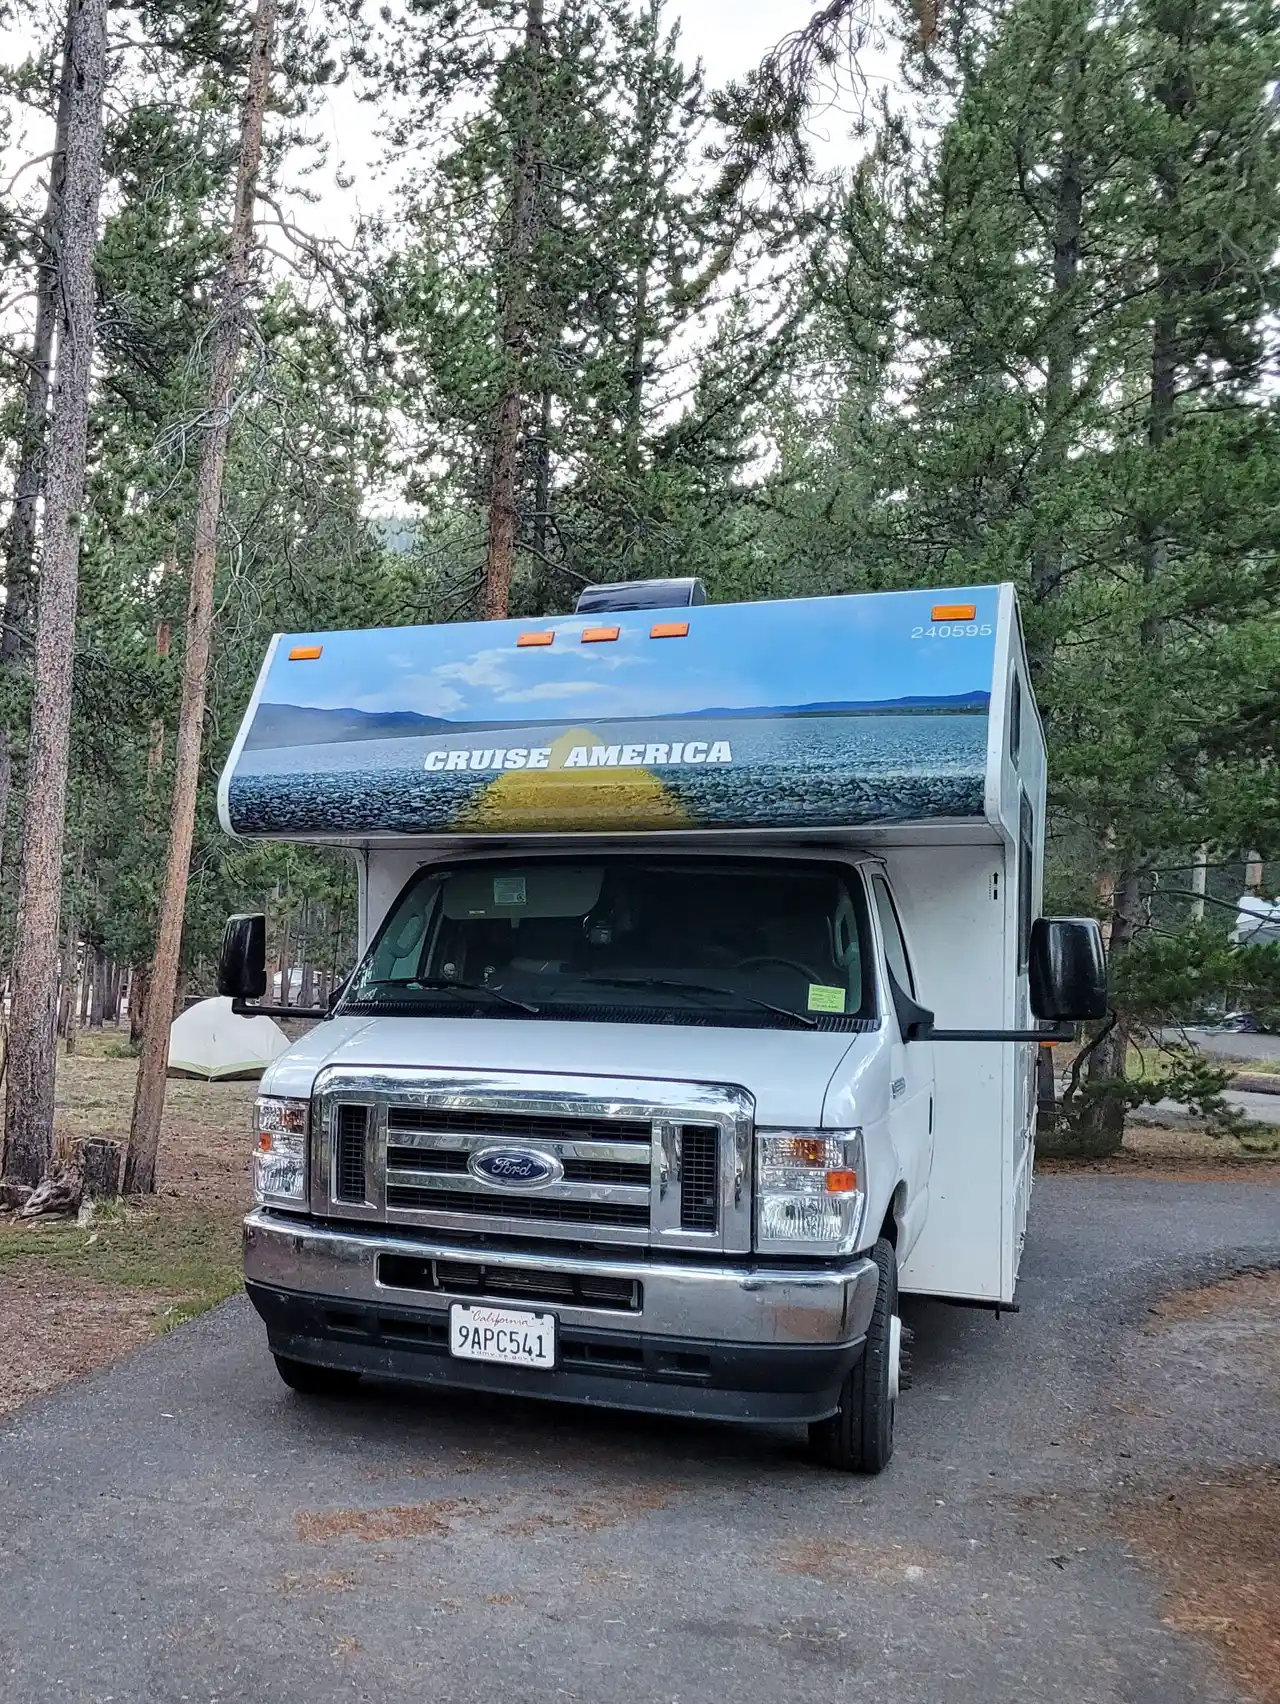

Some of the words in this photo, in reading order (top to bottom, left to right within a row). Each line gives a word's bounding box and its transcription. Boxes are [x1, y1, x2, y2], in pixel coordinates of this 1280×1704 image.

[911, 624, 992, 639] 240595
[424, 747, 552, 771] CRUISE
[563, 741, 733, 767] AMERICA
[491, 1157, 532, 1176] Ford
[472, 1310, 535, 1327] California
[458, 1325, 547, 1359] 9APC541
